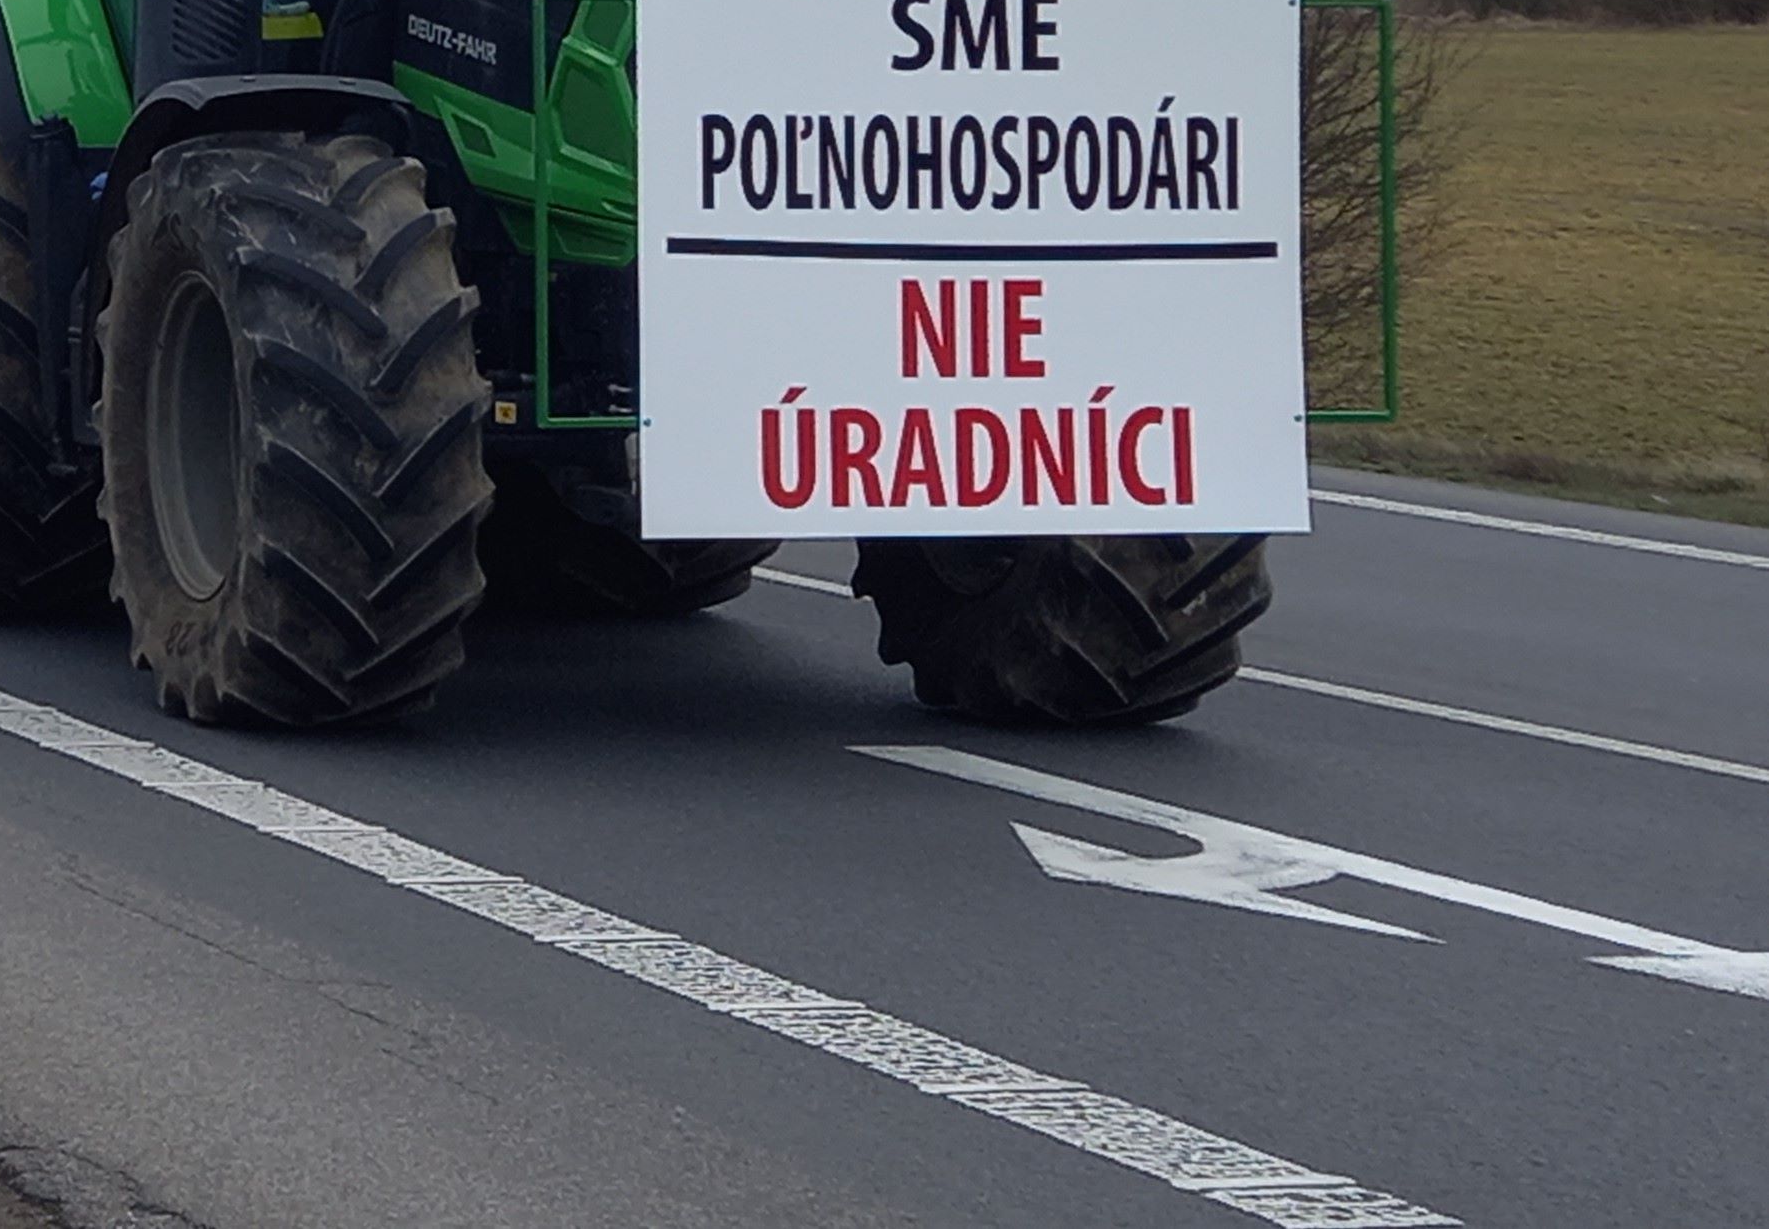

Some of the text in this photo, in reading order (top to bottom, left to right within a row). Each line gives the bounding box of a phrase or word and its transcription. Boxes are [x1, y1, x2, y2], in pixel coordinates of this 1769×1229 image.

[407, 13, 497, 65] DEUTZ-FAHR
[702, 97, 1239, 211] POĽNOHOSPODÁRI
[902, 280, 1045, 377] NIE
[761, 386, 1194, 508] ÚRADNÍCI
